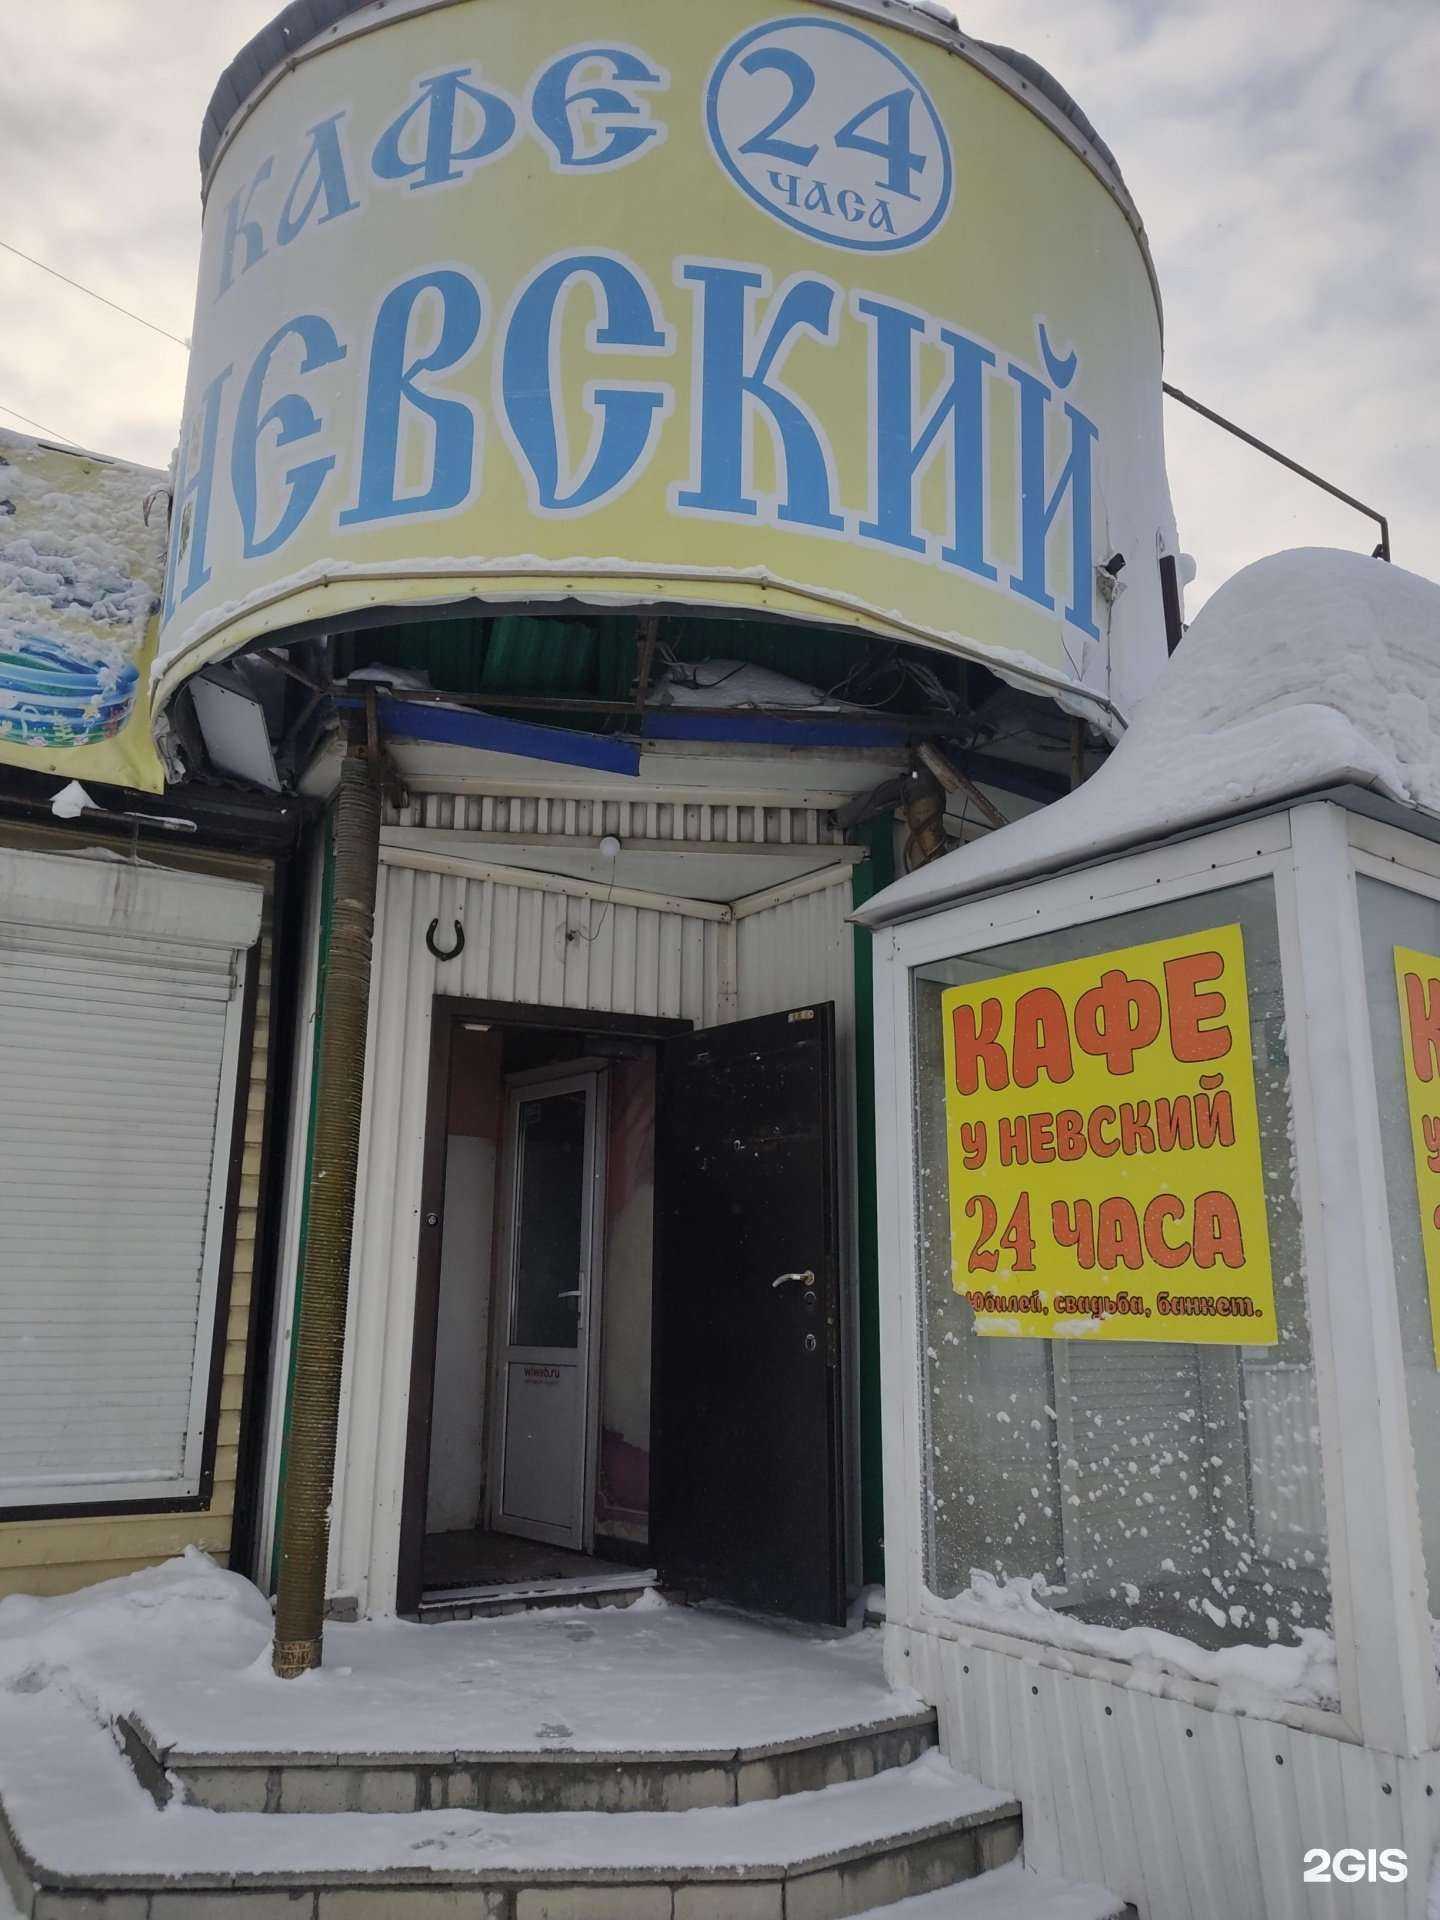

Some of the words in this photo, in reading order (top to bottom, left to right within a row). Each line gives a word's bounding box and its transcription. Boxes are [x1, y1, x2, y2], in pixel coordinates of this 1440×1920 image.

[215, 48, 661, 303] КАФЕ
[738, 47, 927, 202] 24
[766, 169, 897, 235] ЧАСА
[161, 255, 1099, 641] НЕВСКИЙ
[953, 951, 1232, 1096] КАФЕ
[999, 1073, 1236, 1167] НЕВСКИЙ
[965, 1192, 1036, 1273] 24
[1051, 1191, 1246, 1270] ЧАСА
[1054, 1291, 1151, 1320] свадьба,
[1157, 1291, 1263, 1317] банкет.
